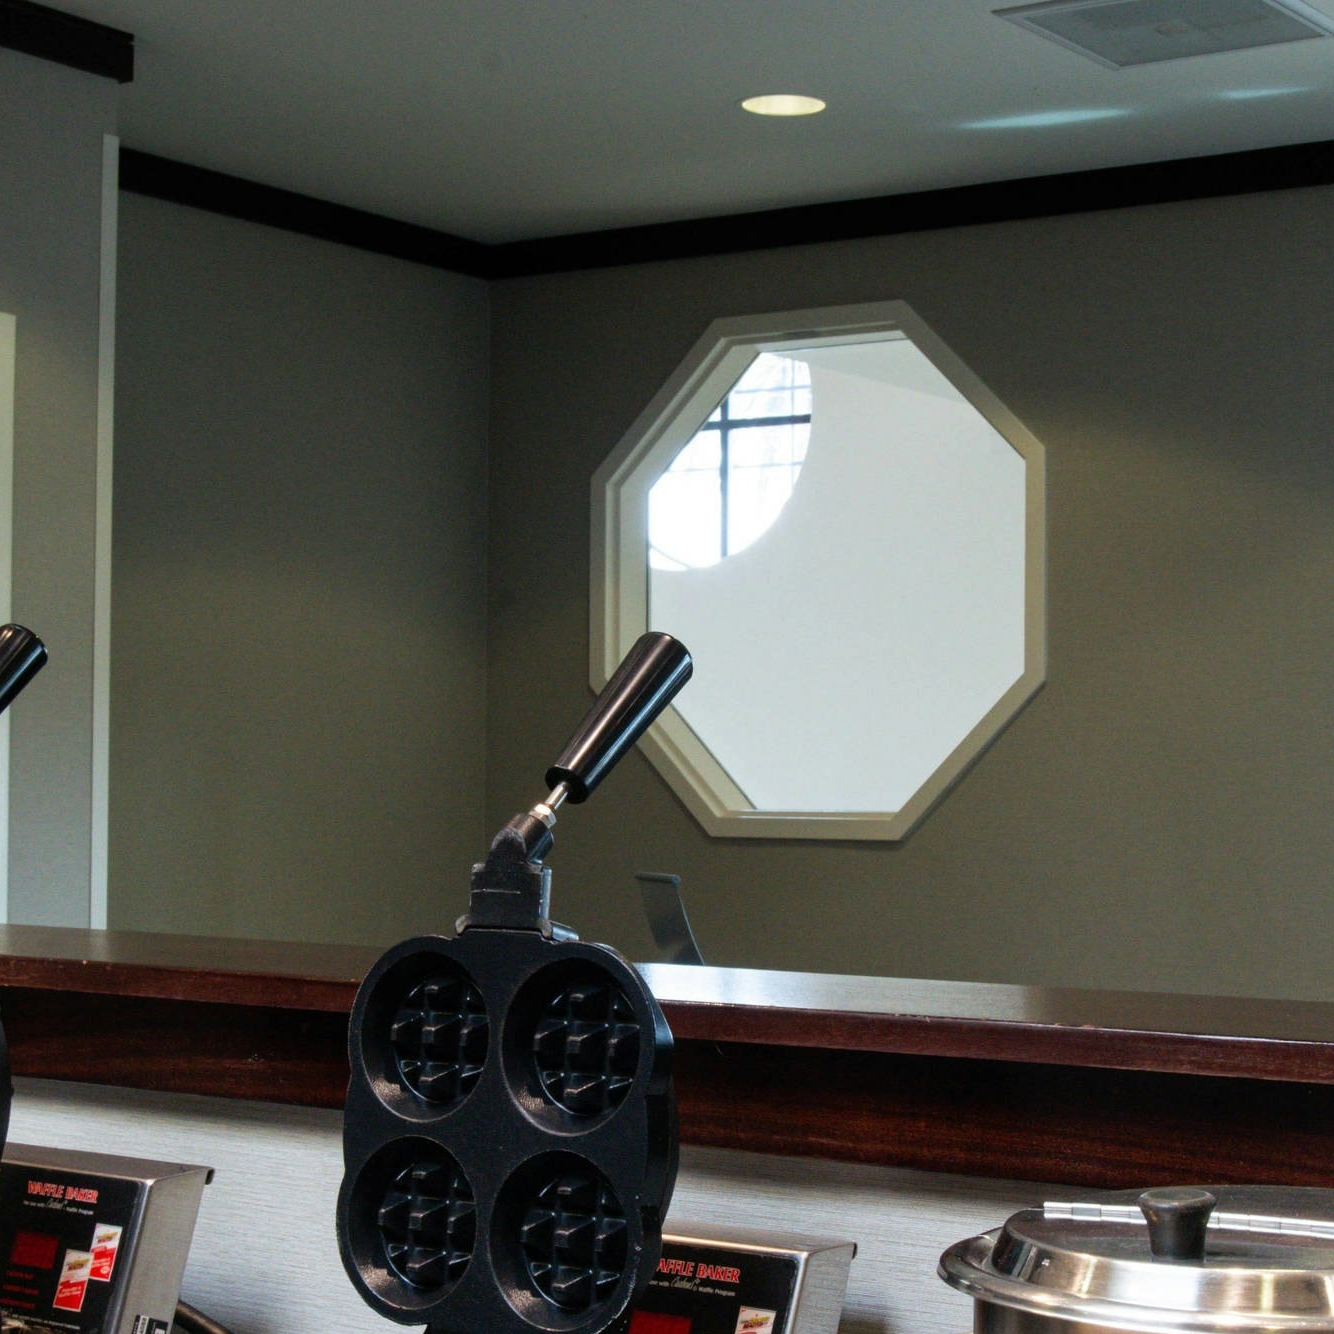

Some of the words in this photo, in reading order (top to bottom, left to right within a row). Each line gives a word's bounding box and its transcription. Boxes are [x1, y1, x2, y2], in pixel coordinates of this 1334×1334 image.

[27, 1180, 64, 1198] WAFFLE
[64, 1186, 99, 1204] BAKER
[656, 1257, 695, 1278] AFFLE
[695, 1262, 741, 1284] BAKER
